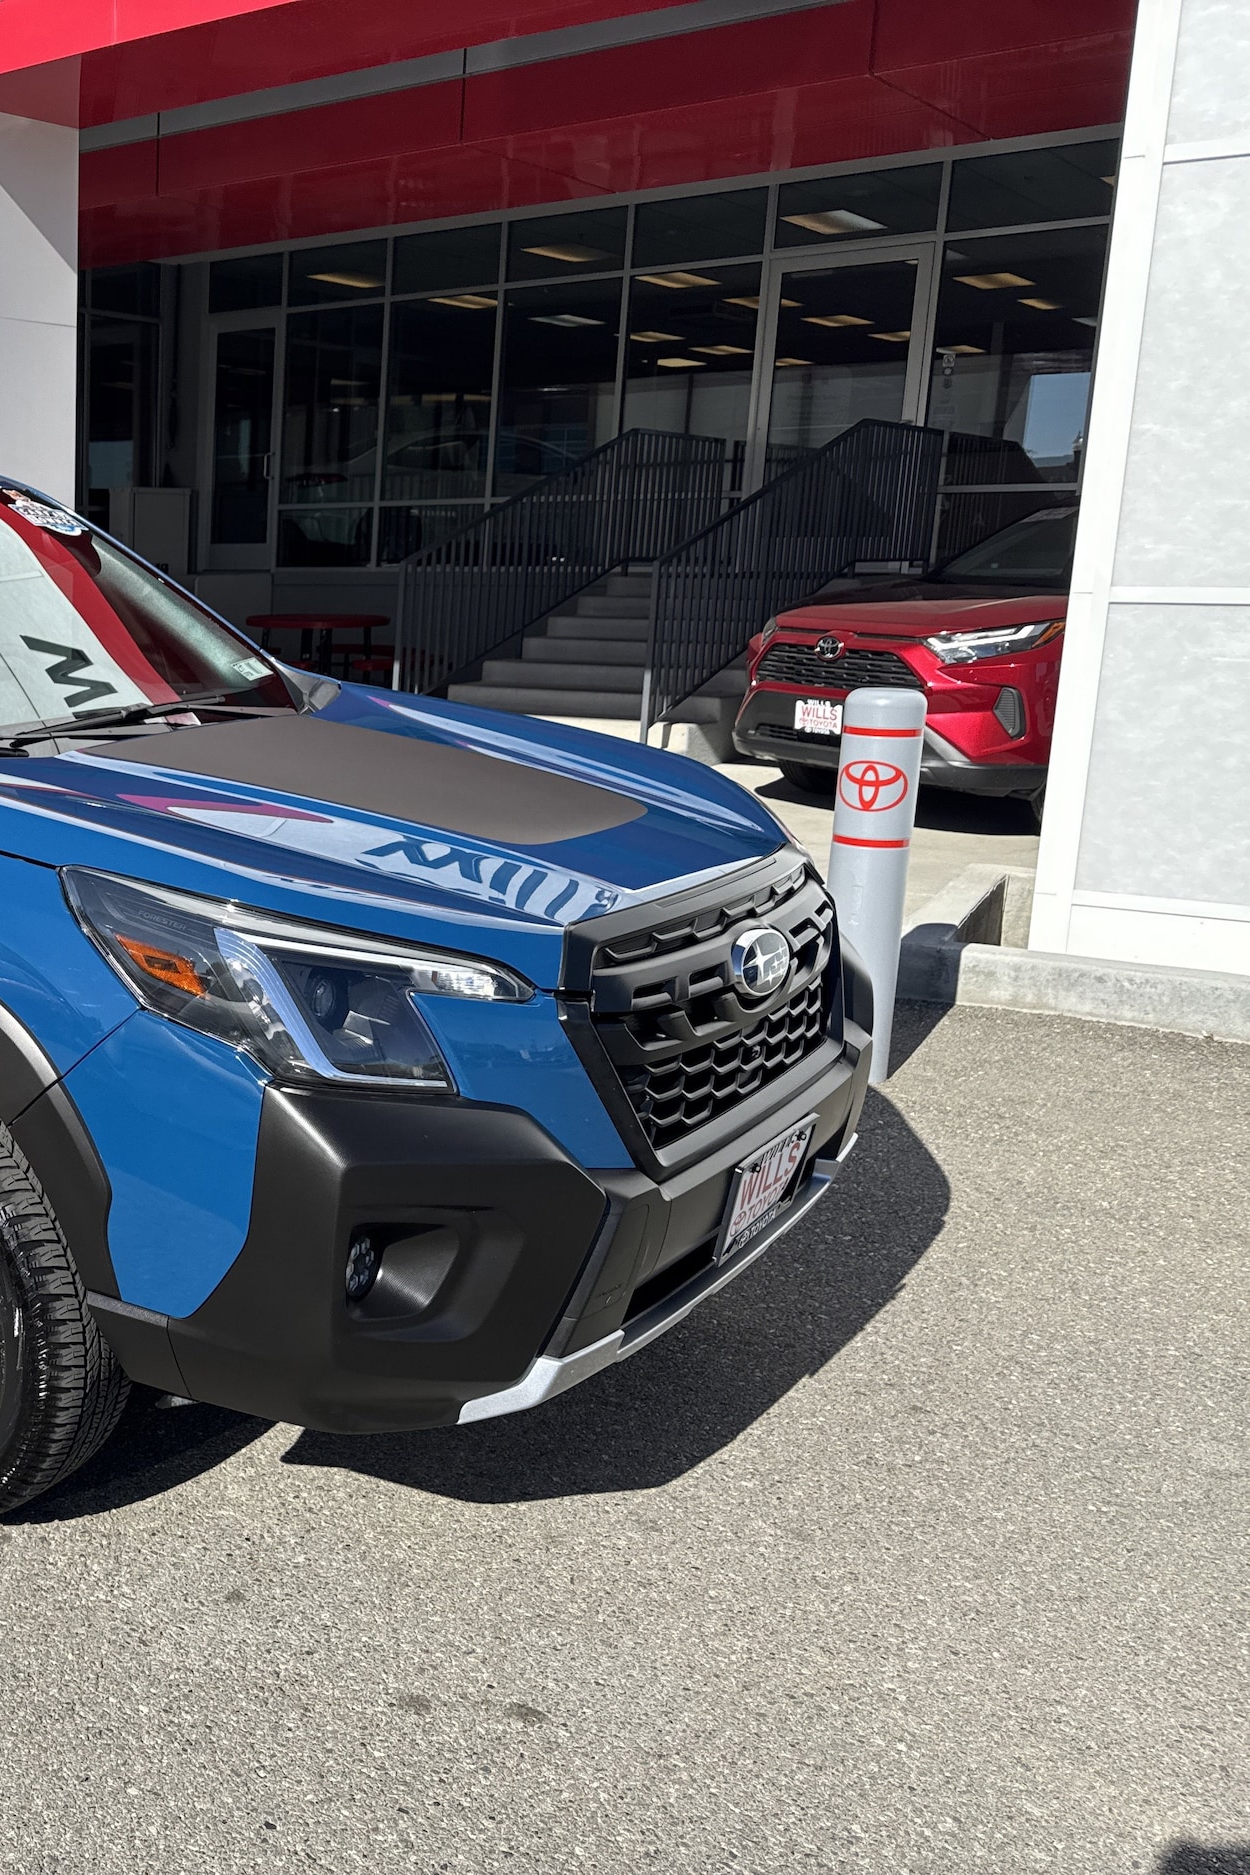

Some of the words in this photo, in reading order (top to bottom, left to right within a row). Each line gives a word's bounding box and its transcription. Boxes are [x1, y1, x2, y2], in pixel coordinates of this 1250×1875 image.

[801, 705, 838, 721] WILLS
[810, 718, 838, 729] TOYOTA
[137, 910, 187, 931] FORESTER
[739, 1141, 801, 1211] WILLS
